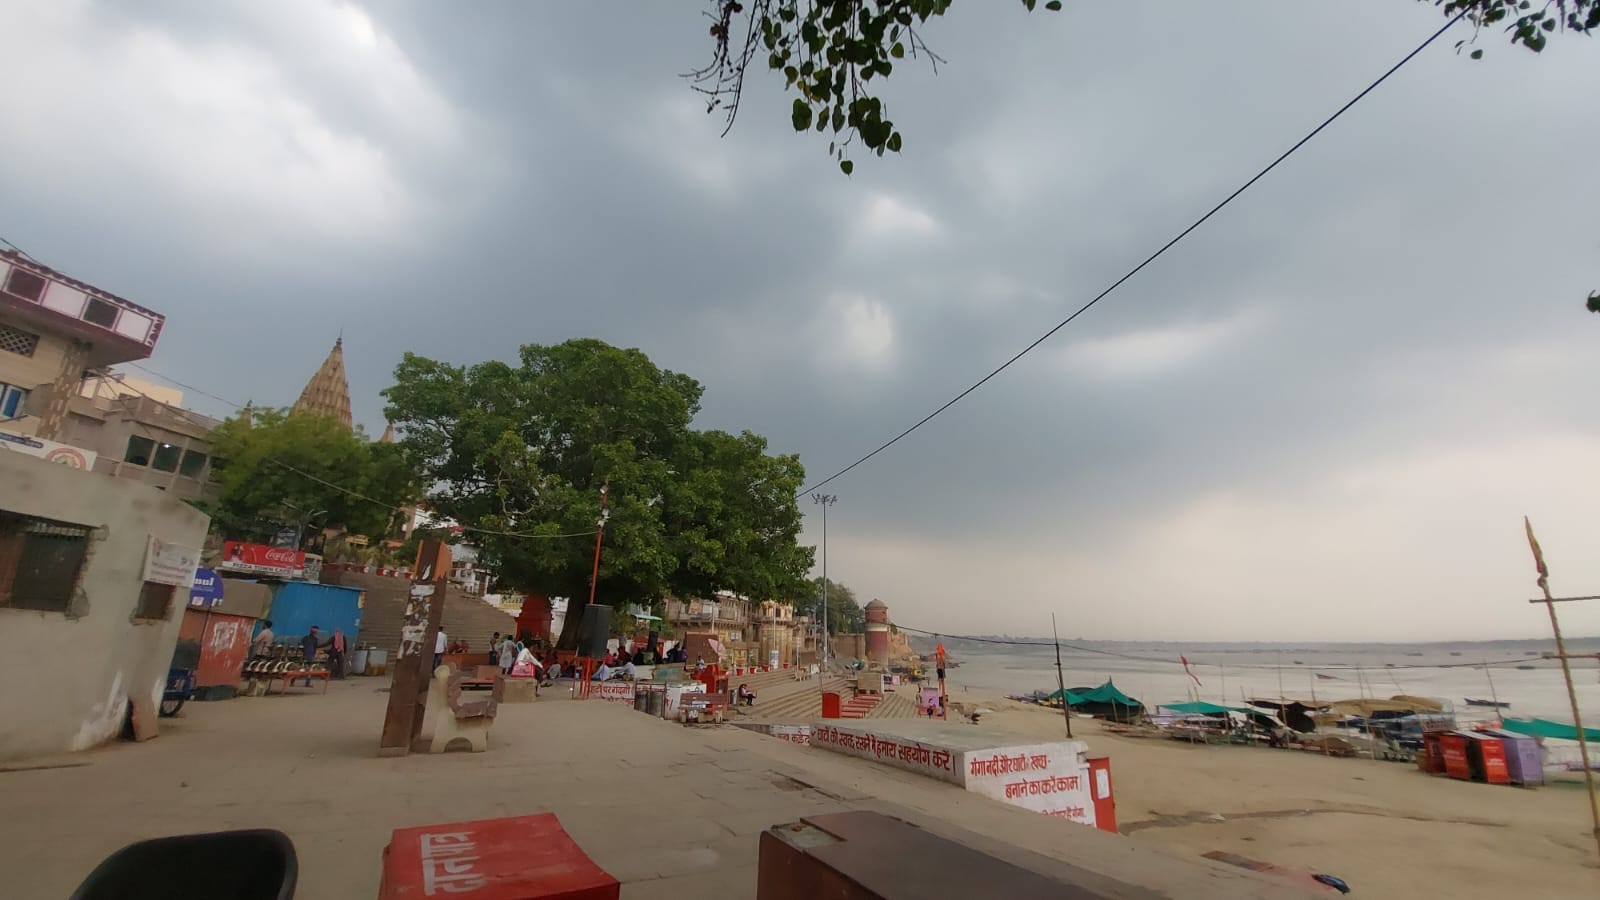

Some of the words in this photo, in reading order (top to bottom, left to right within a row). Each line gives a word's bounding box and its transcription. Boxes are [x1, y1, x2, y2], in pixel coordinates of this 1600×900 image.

[899, 742, 930, 766] सहयोग
[1005, 778, 1028, 798] बनाने
[1056, 776, 1078, 791] काम
